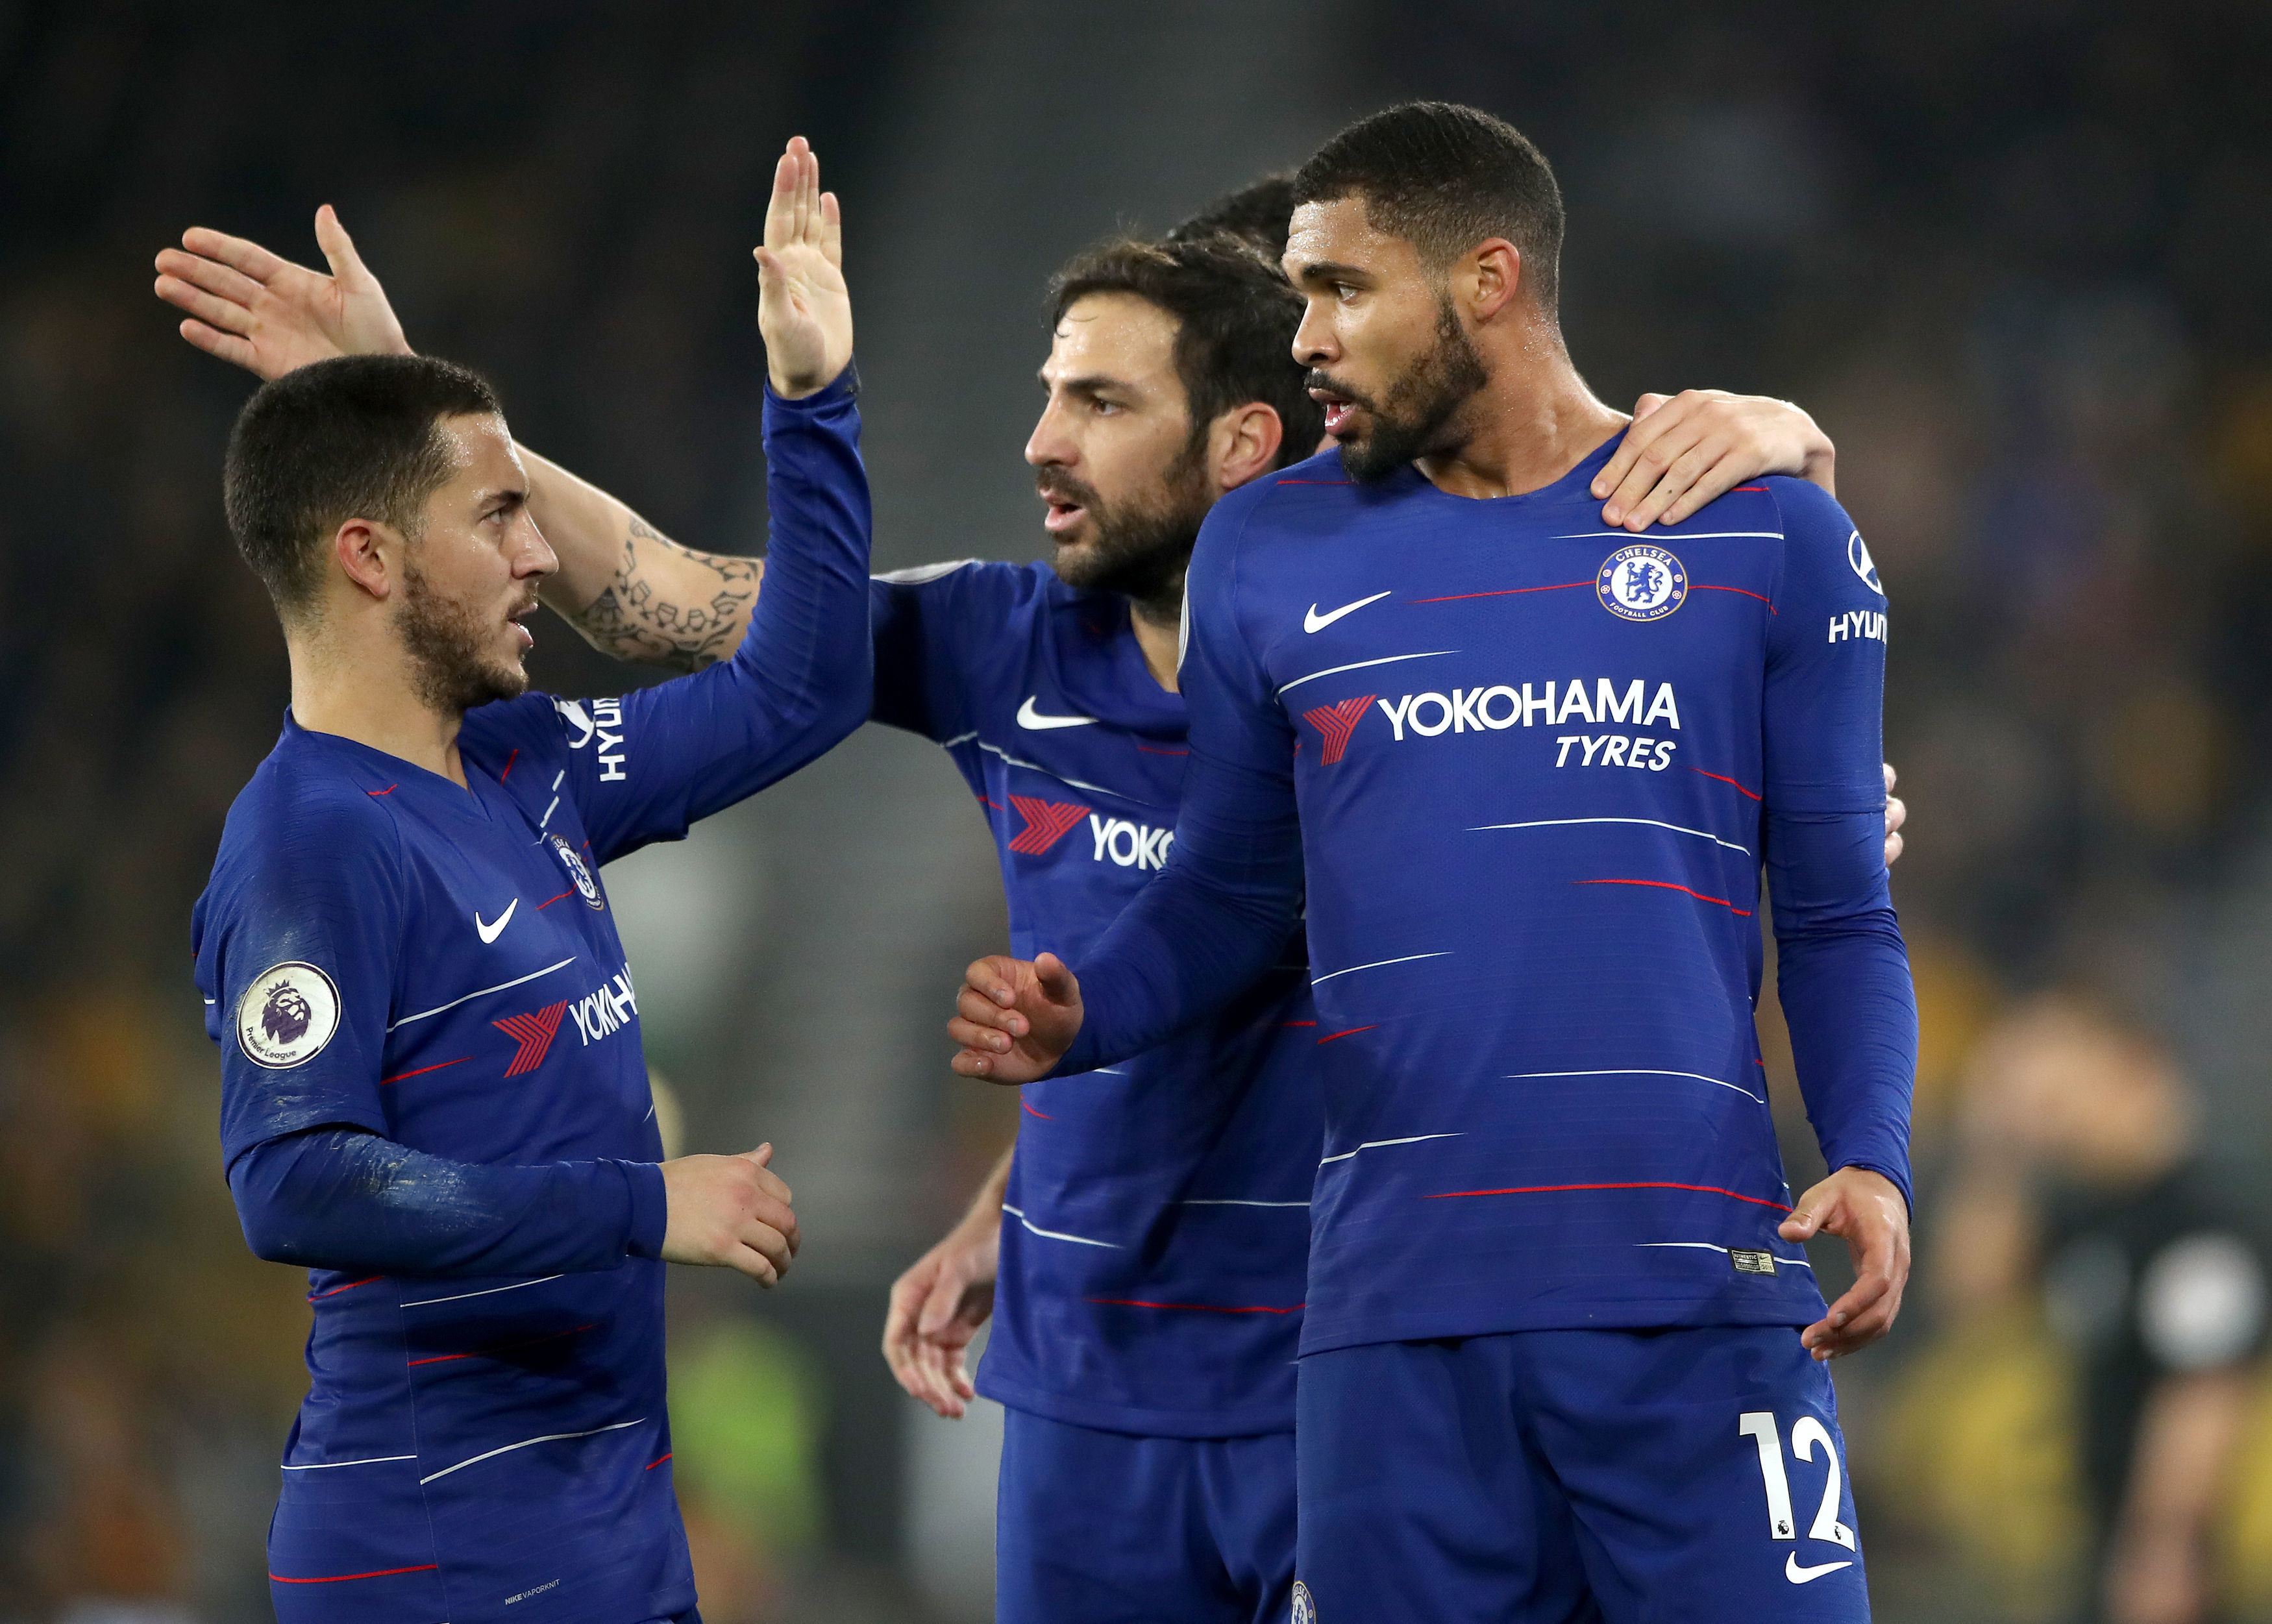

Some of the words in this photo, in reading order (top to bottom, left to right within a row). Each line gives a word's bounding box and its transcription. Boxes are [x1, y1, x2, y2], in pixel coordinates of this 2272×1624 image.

[1615, 548, 1673, 566] CHELSEA
[1609, 602, 1646, 617] FOOTBALL
[1649, 606, 1669, 616] CLUB
[1828, 610, 1887, 645] HYUN
[1377, 678, 1680, 741] YOKOHAMA
[1555, 735, 1677, 772] TYRES
[246, 1026, 264, 1054] Premier
[265, 1048, 297, 1061] League
[1739, 1411, 1856, 1553] 12
[504, 1593, 523, 1605] NIKE
[522, 1579, 560, 1599] VAPORKNIT
